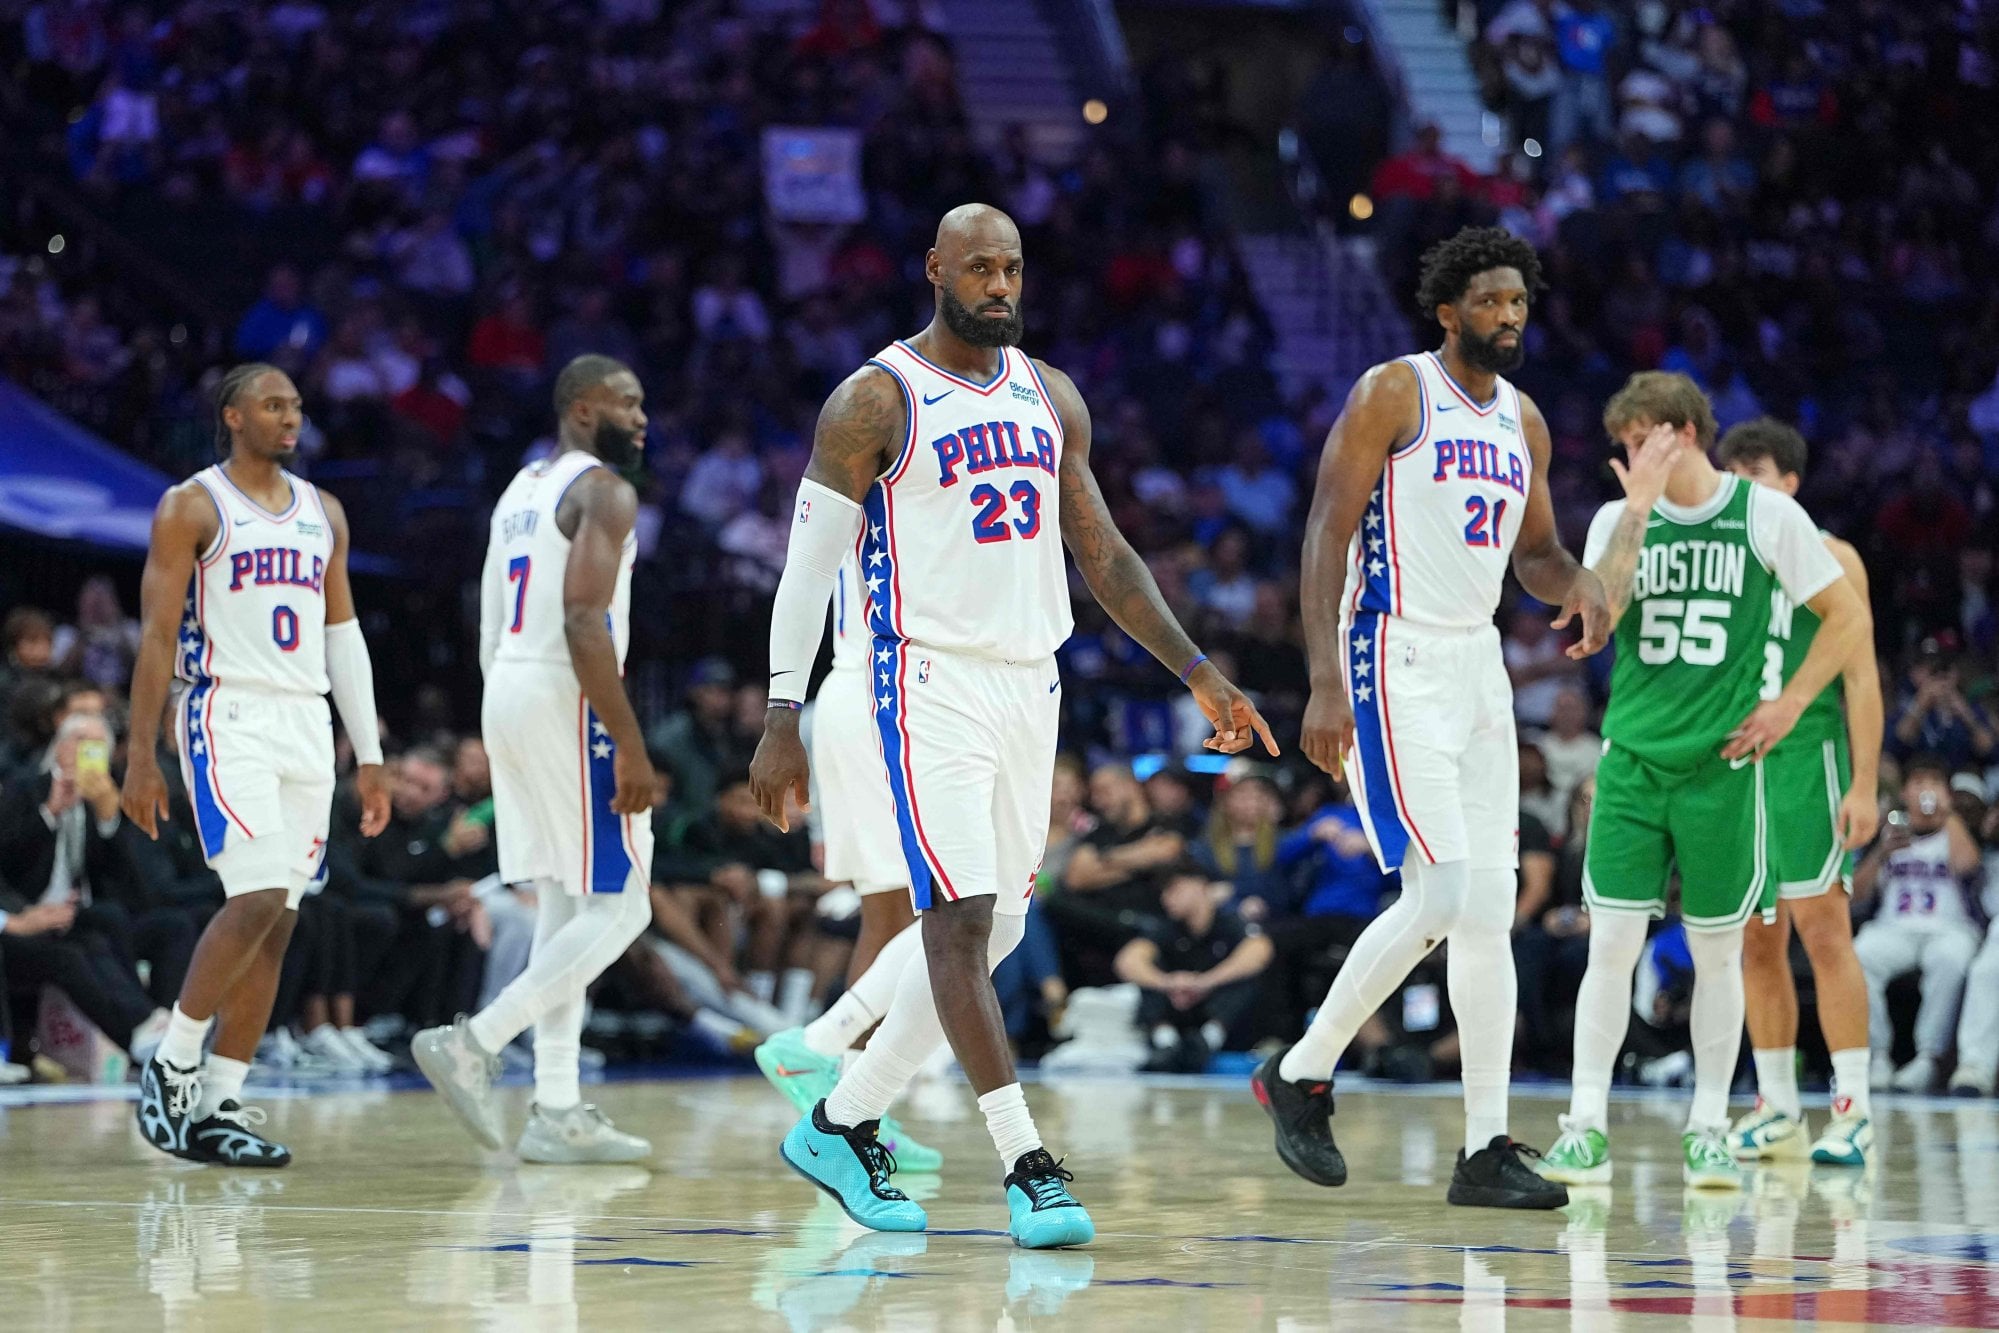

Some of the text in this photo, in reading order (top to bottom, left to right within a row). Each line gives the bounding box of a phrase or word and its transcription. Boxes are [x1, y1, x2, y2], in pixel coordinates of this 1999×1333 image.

[1009, 381, 1038, 398] Bloom
[1012, 392, 1039, 406] energy
[932, 421, 1056, 488] PHILA
[1433, 439, 1525, 497] PHILA
[970, 480, 1041, 544] 23
[1465, 495, 1507, 548] 21
[229, 548, 322, 596] PHILA
[509, 555, 531, 634] 7
[1633, 540, 1746, 601] BOSTON
[272, 604, 299, 652] 0
[1639, 599, 1731, 666] 55
